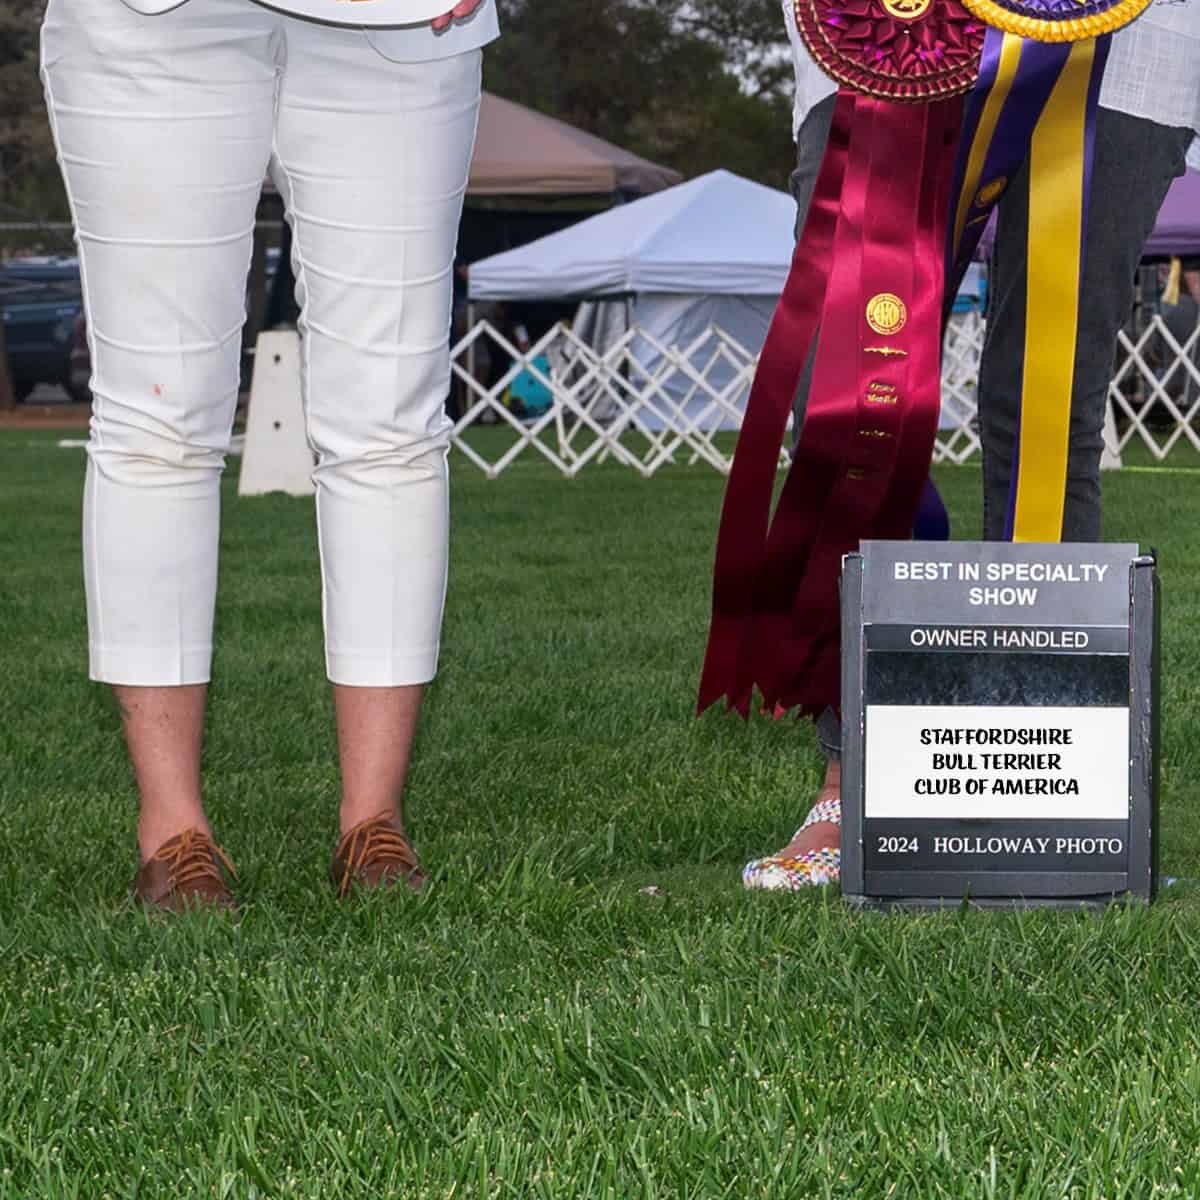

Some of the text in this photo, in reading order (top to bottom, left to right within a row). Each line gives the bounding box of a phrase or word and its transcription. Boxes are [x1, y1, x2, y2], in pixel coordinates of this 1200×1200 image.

[894, 562, 1108, 582] BEST IN SPECIALTY
[969, 587, 1037, 605] SHOW
[910, 629, 1089, 648] OWNER HANDLED
[920, 728, 1073, 745] STAFFORDSHIRE
[933, 753, 1062, 770] BULL TERRIER
[914, 779, 1080, 796] CLUB OF AMERICA
[878, 837, 1123, 854] 2024 HOLLOWAY PHOTO
